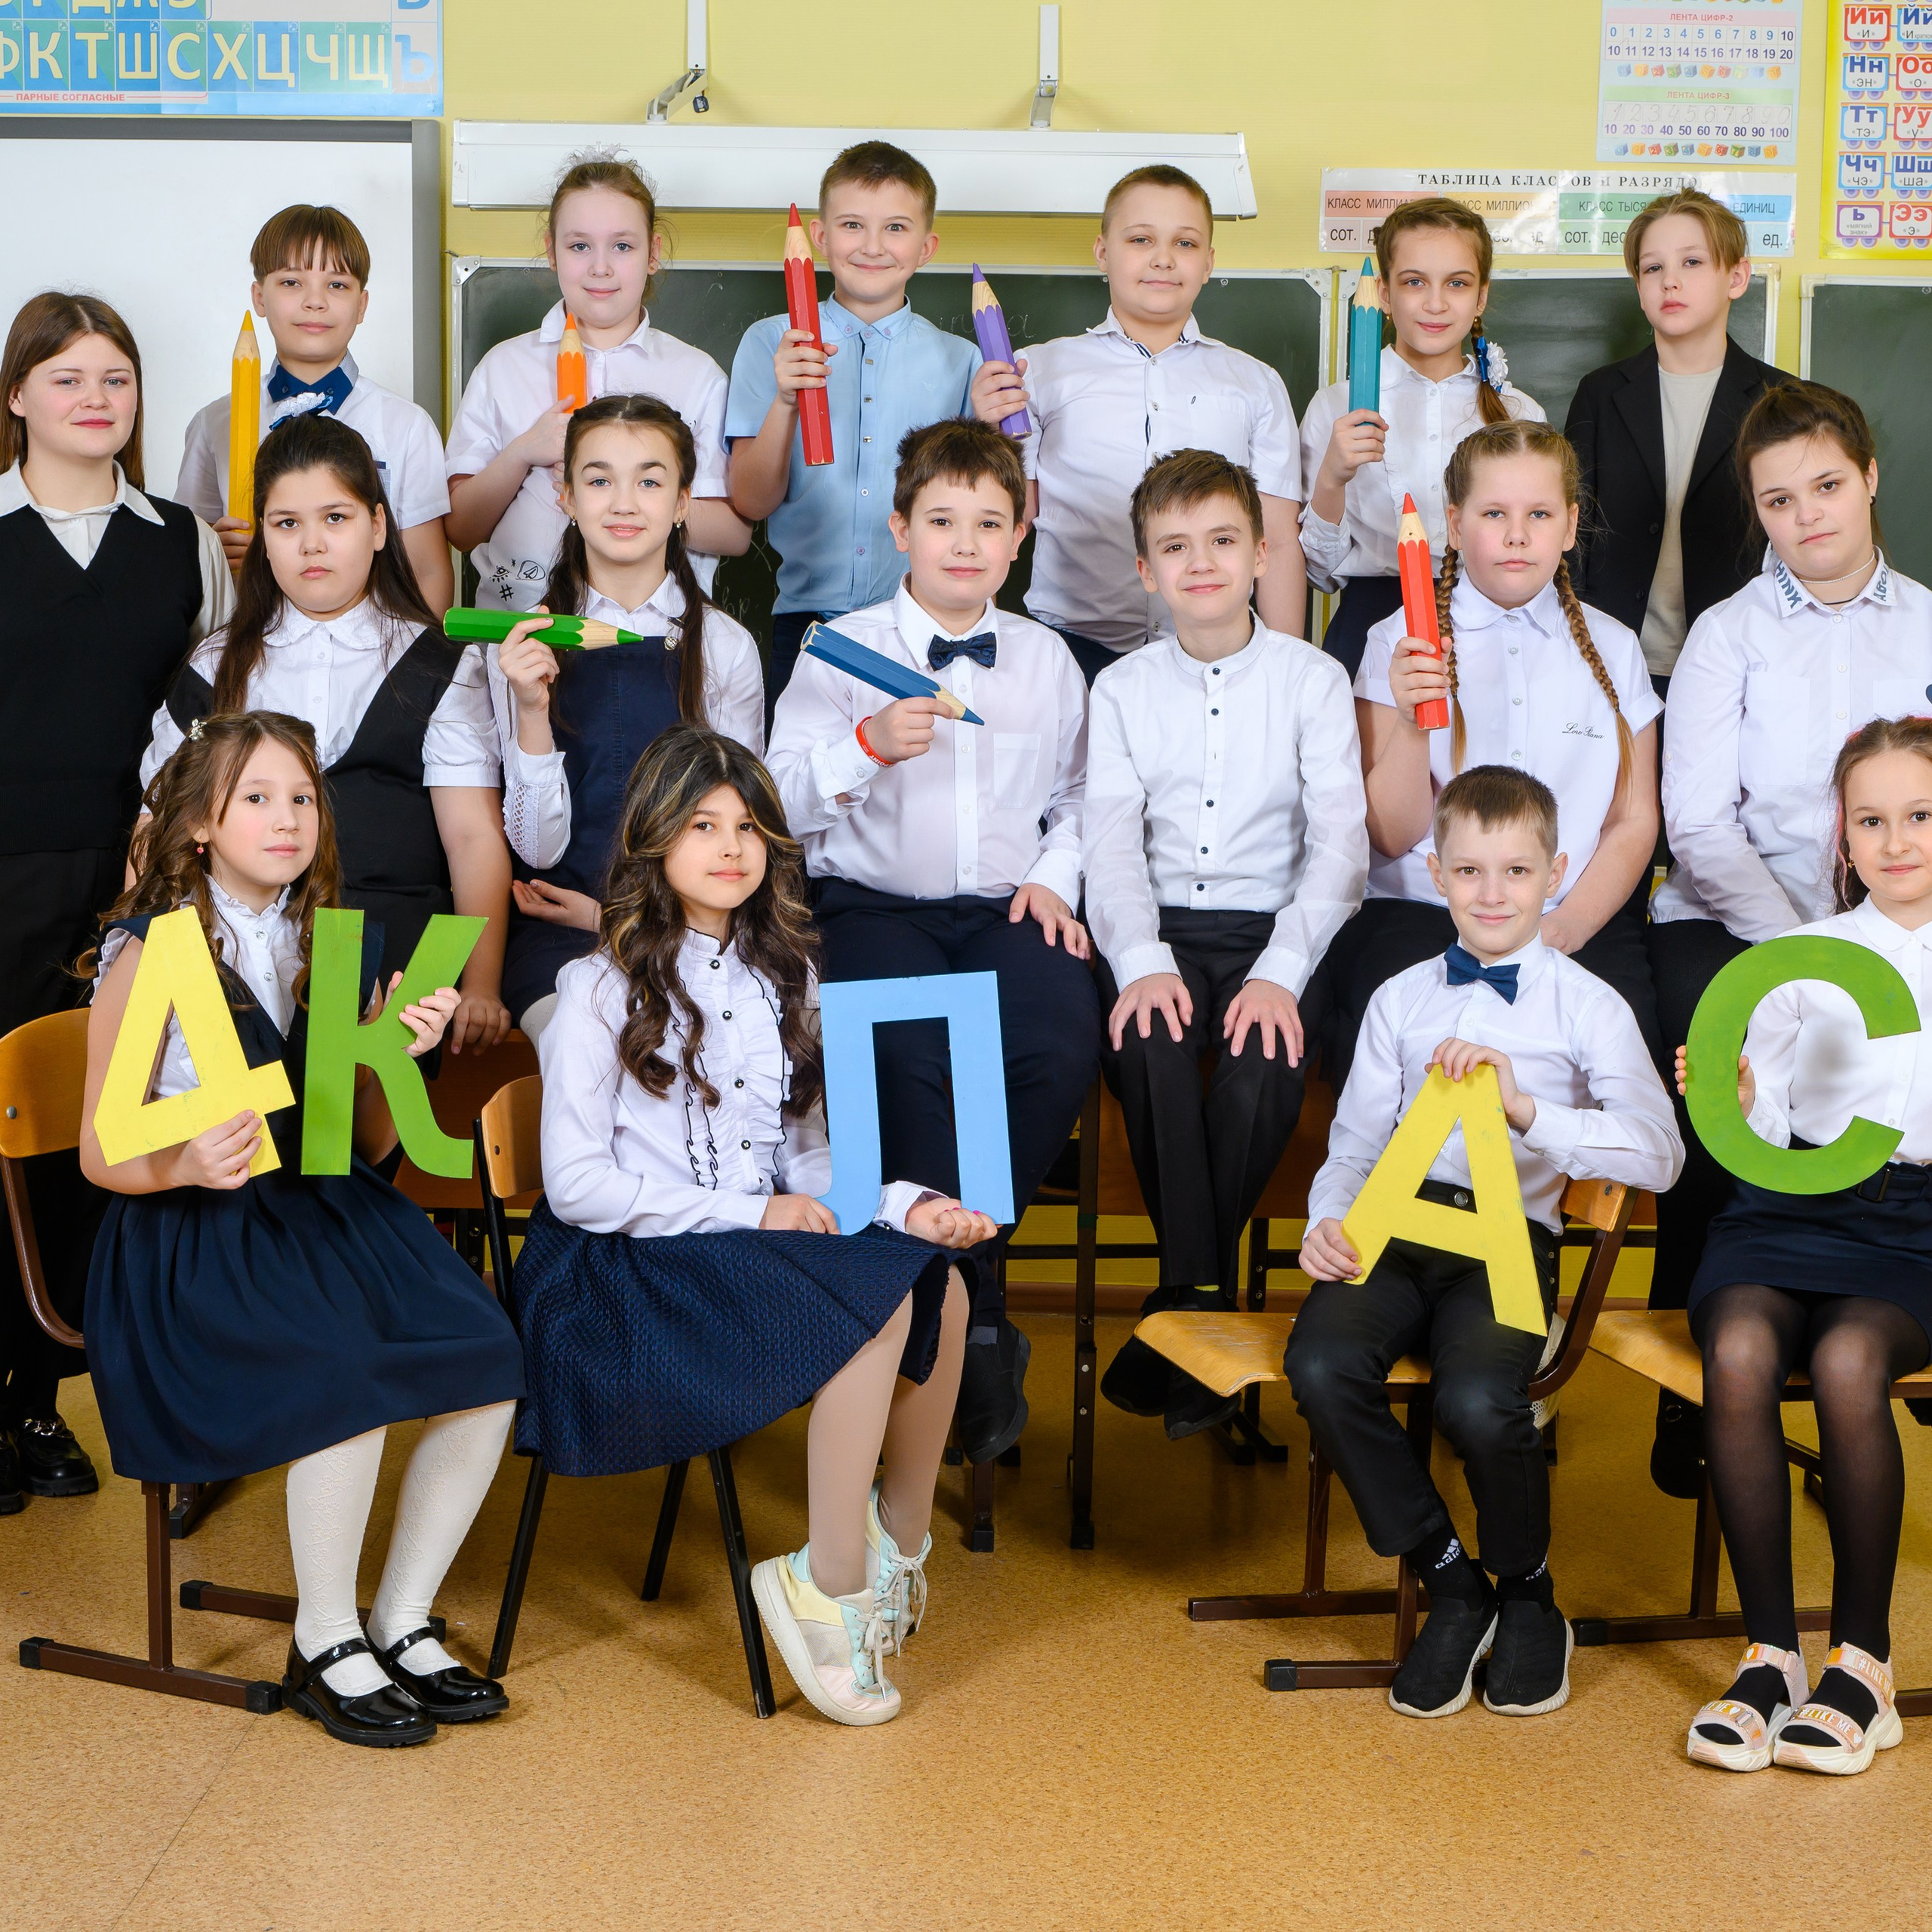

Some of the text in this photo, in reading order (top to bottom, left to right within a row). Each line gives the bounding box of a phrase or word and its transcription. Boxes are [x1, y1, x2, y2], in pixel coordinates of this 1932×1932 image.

[1850, 8, 1884, 25] Ии
[1610, 26, 1794, 41] 0 1 2 3 4 5 6 7 8 9 10
[29, 32, 63, 78] К
[75, 32, 109, 79] Т
[118, 32, 157, 79] Ш
[167, 32, 201, 80] С
[212, 33, 248, 80] Х
[257, 33, 295, 88] Ц
[306, 34, 339, 81] Ч
[348, 34, 389, 88] Щ
[1607, 45, 1793, 60] 10 11 12 13 14 15 16 17 18 19 20
[1849, 56, 1883, 72] Нн
[1902, 57, 1932, 74] Оо
[16, 93, 125, 102] ПАРНЫЕ СОГЛАСНЫЕ
[1850, 106, 1878, 122] Тт
[1902, 106, 1931, 128] Уу
[1604, 124, 1789, 137] 10 20 30 40 50 60 70 80 90 100
[1846, 155, 1877, 172] Чч
[1895, 155, 1932, 173] Шш
[1418, 174, 1502, 187] ТАБЛИЦА
[1511, 175, 1591, 186] КЛАСОВ
[1618, 176, 1698, 188] РАЗРЯДО
[1327, 198, 1361, 209] КЛАСС
[1579, 202, 1649, 212] КЛАСС ТЫСЯ
[1733, 202, 1775, 214] ЕДИНИЦ
[1895, 204, 1927, 221] Ээ
[1762, 233, 1783, 248] ед.
[1776, 560, 1803, 609] HINK
[1561, 721, 1583, 735] Loro
[93, 905, 297, 1178] 4
[300, 907, 490, 1179] К
[1685, 935, 1921, 1195] С
[815, 971, 1015, 1236] Л
[1343, 1060, 1548, 1337] А
[1858, 1657, 1884, 1686] #LIKE
[1799, 1707, 1854, 1735] #LIKE ME
